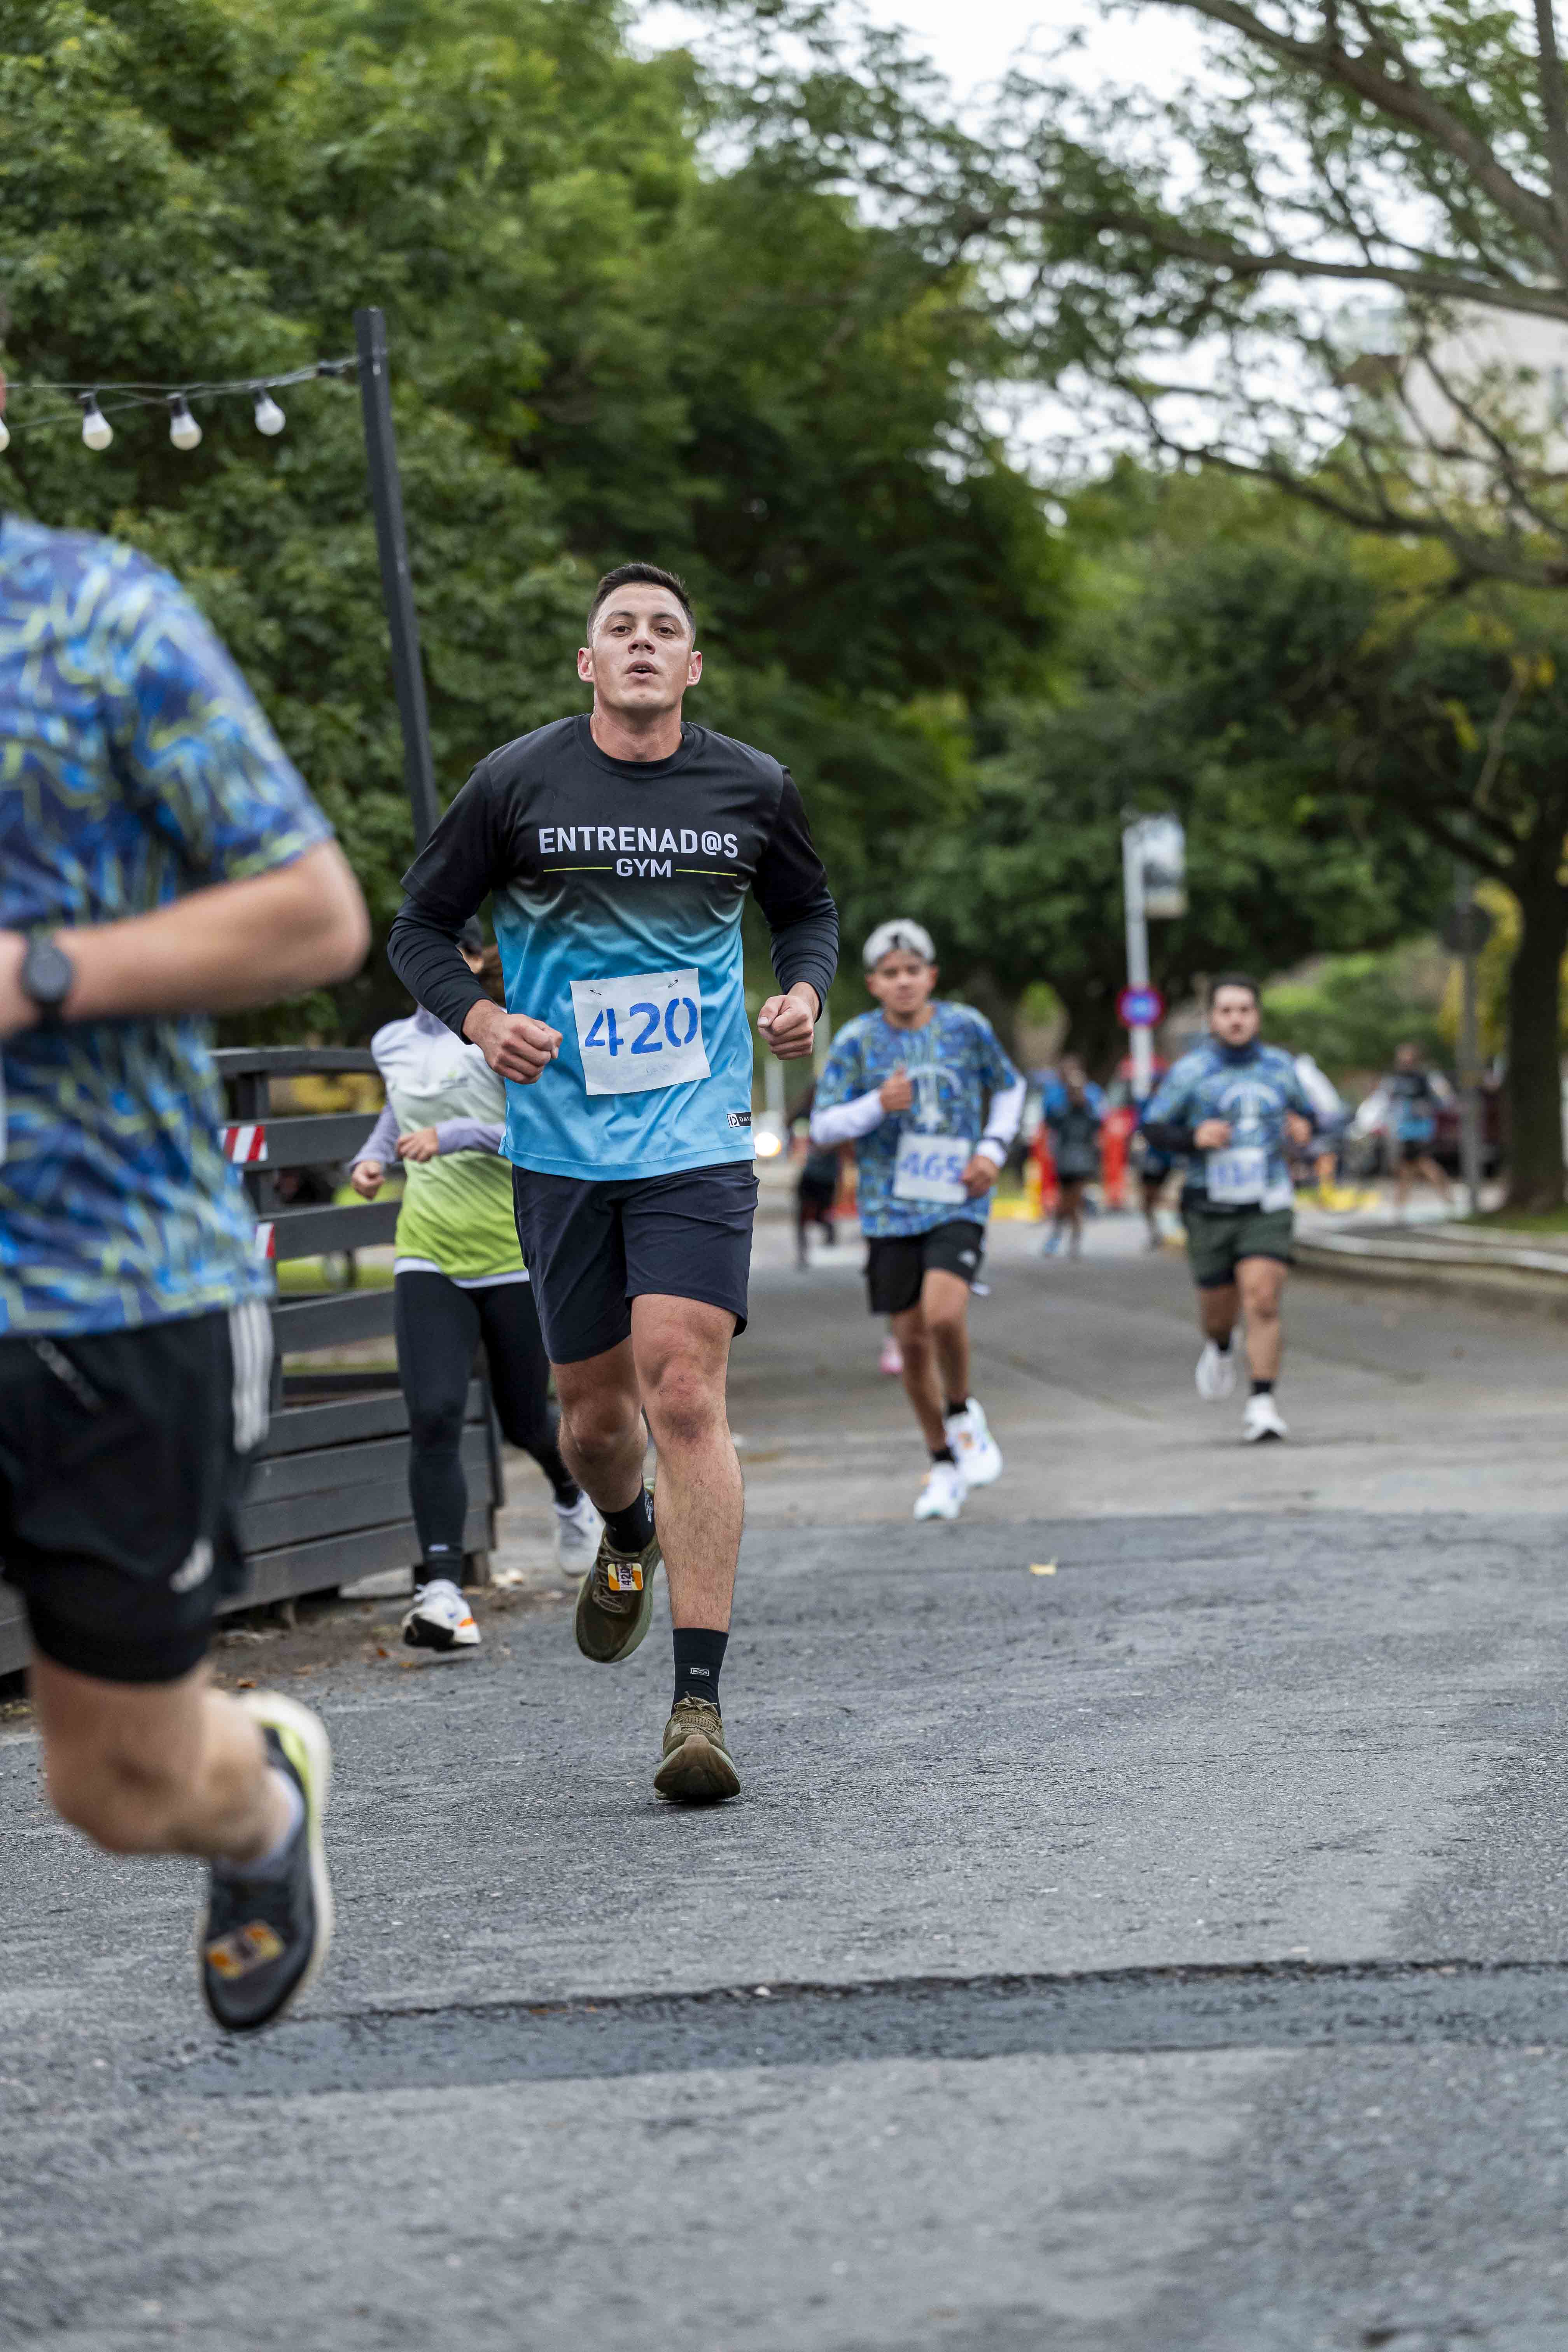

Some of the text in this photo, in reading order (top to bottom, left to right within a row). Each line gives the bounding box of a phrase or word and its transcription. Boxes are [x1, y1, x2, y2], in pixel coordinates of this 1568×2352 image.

[539, 827, 738, 858] ENTRENAD@S
[616, 858, 671, 878] GYM
[584, 997, 698, 1056] 420
